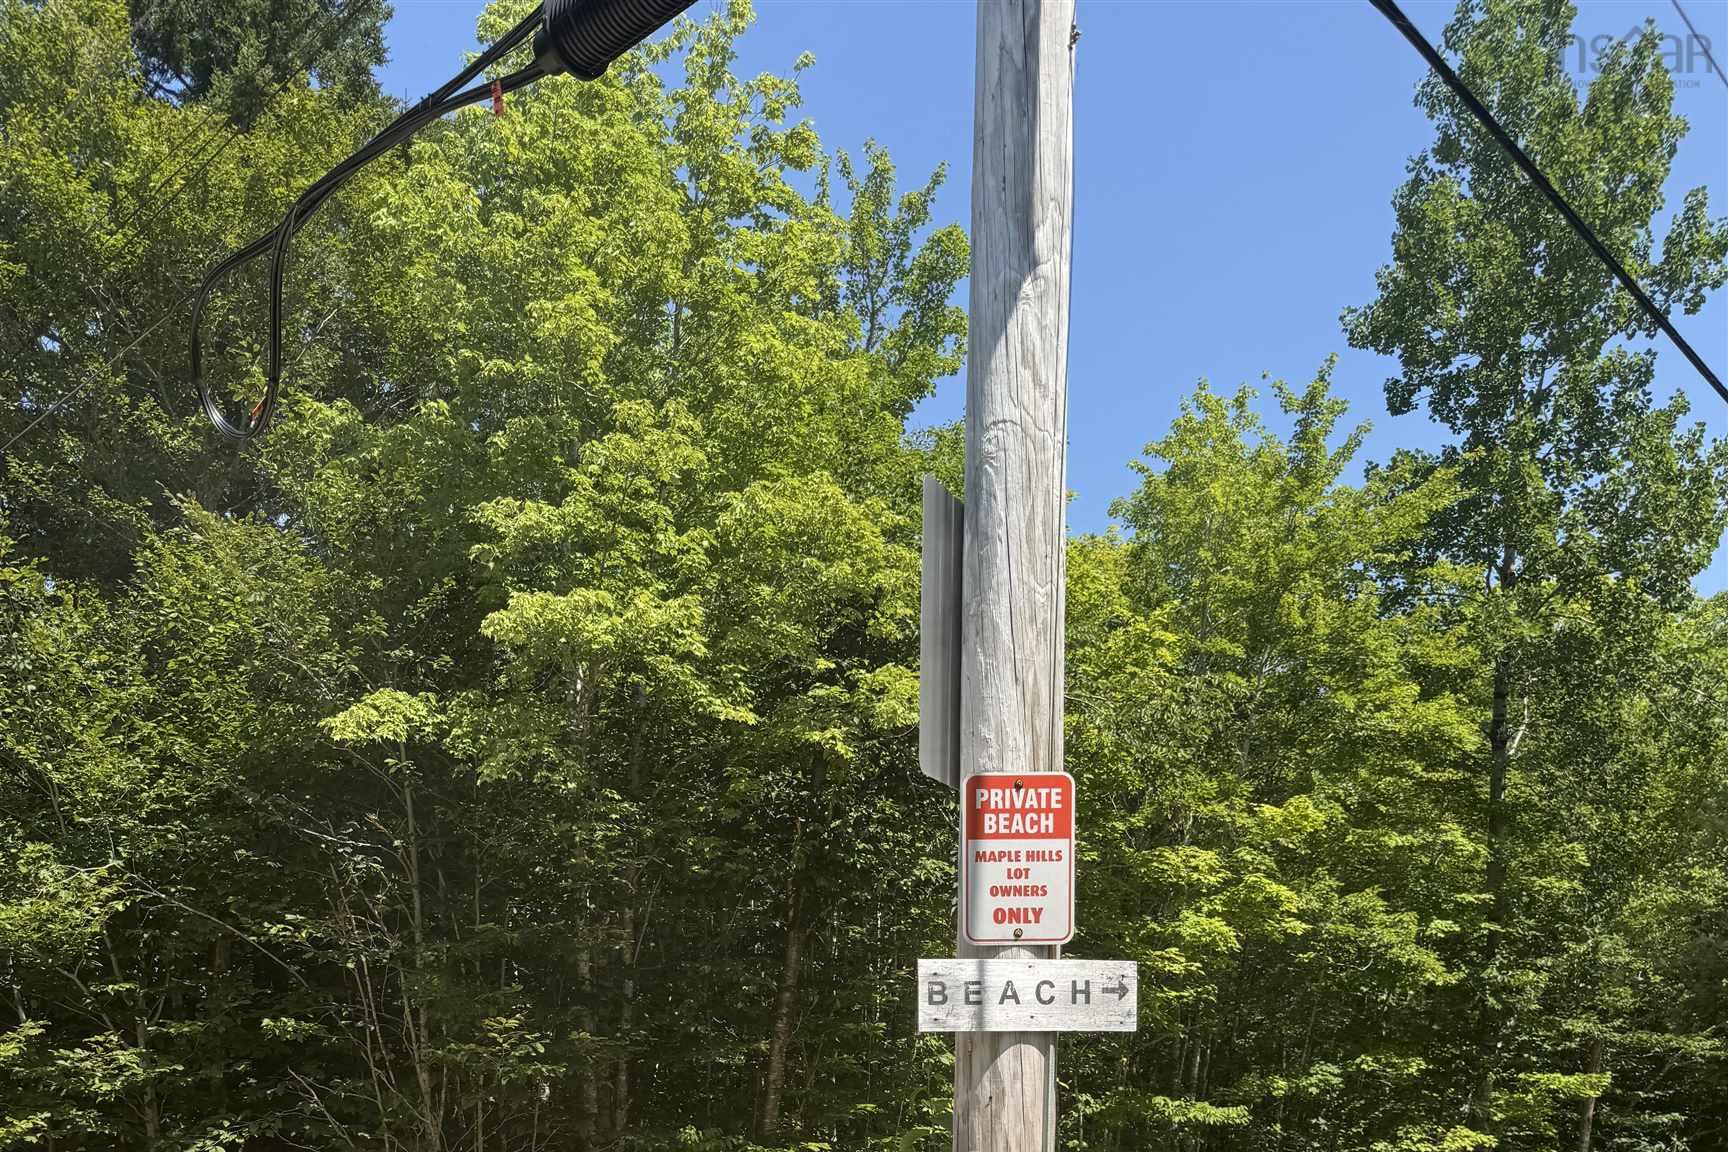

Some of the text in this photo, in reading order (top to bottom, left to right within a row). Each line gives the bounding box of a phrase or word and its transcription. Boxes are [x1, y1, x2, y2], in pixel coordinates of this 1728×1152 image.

[975, 788, 1062, 810] PRIVATE
[984, 813, 1054, 834] BEACH
[974, 850, 1063, 863] MAPLE HILLS
[1006, 867, 1031, 880] LOT
[989, 885, 1048, 897] OWNERS
[992, 907, 1044, 925] ONLY
[927, 980, 1090, 1006] BEACH
